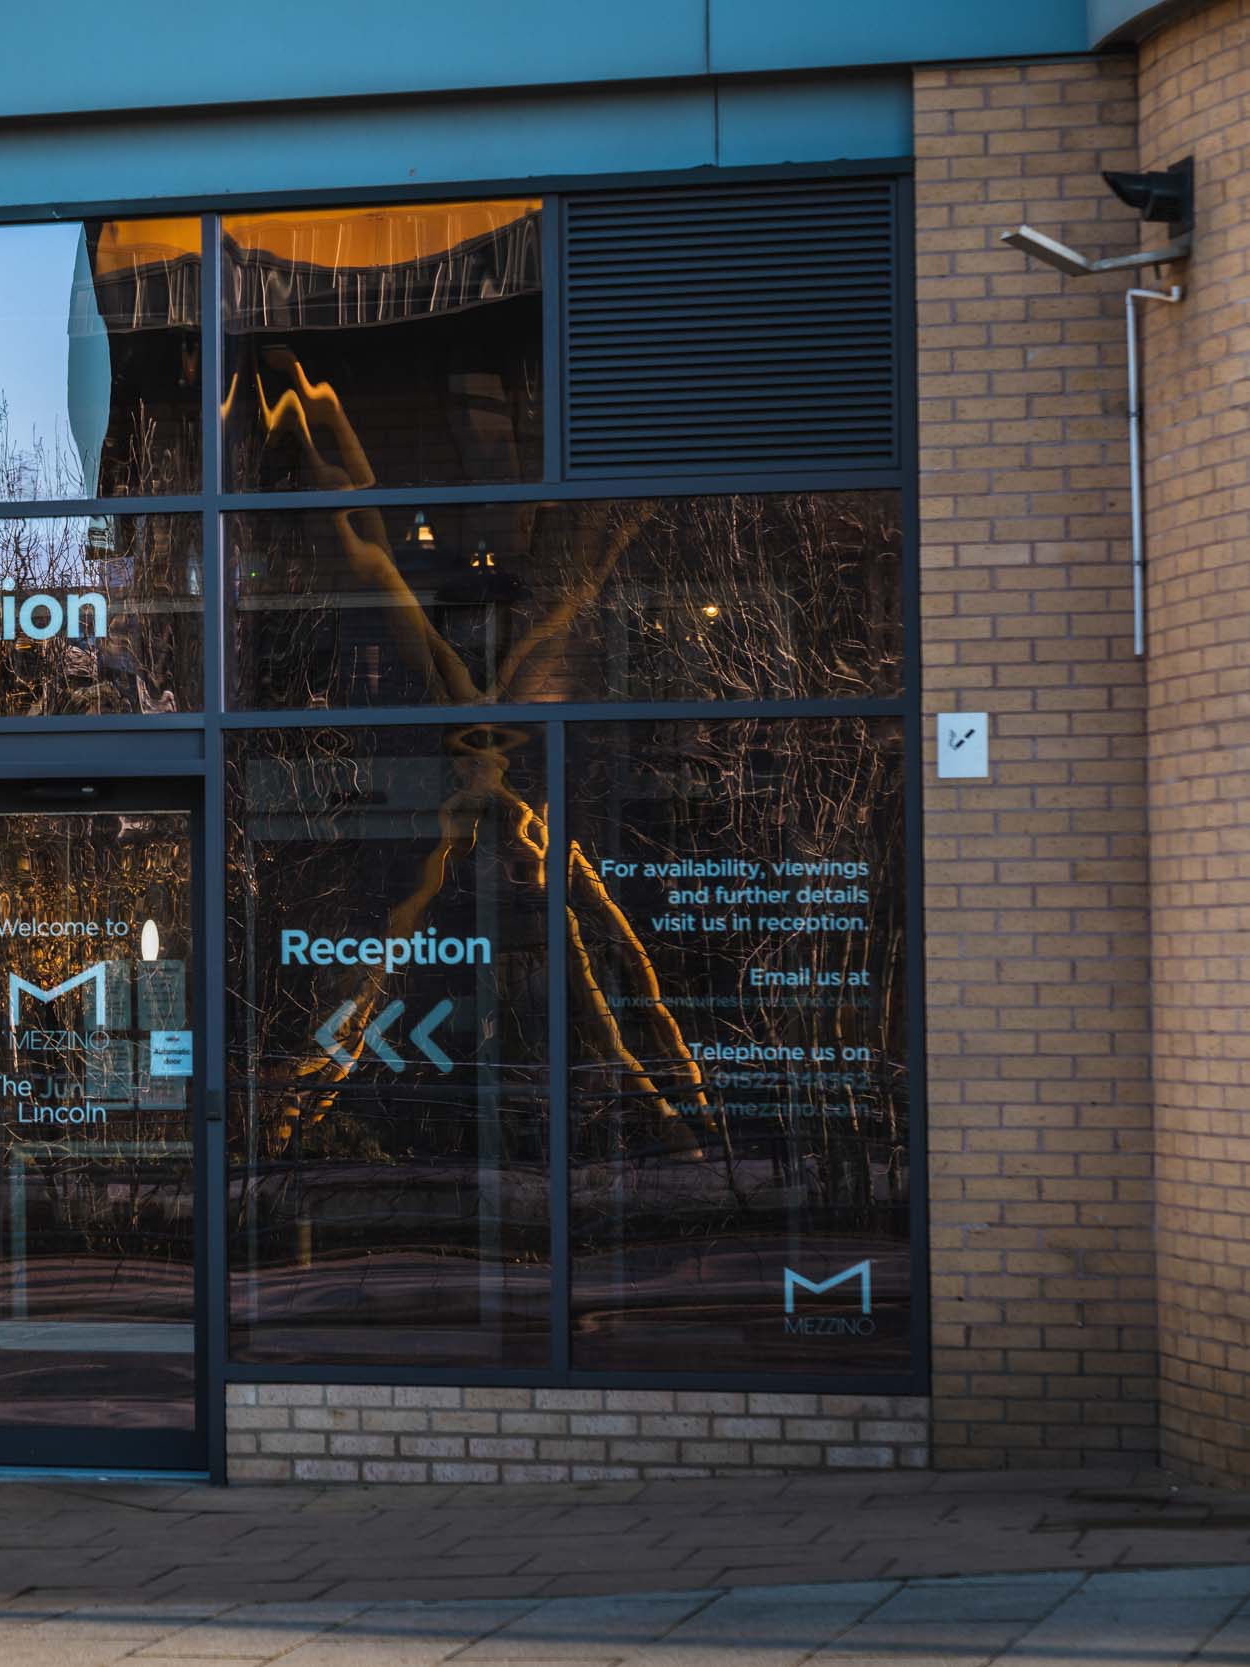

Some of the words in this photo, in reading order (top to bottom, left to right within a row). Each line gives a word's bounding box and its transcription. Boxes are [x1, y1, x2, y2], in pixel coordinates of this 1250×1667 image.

[601, 860, 636, 878] For
[643, 859, 767, 880] availability,
[773, 859, 869, 880] viewings
[668, 886, 709, 905] and
[715, 886, 792, 905] further
[796, 885, 869, 905] details
[106, 919, 128, 937] to
[652, 913, 695, 932] visit
[701, 917, 727, 932] us
[731, 912, 751, 933] in
[757, 913, 869, 935] reception.
[281, 927, 491, 974] Reception
[750, 968, 813, 987] Email
[817, 972, 842, 987] us
[846, 969, 869, 987] at
[10, 1030, 110, 1051] MEZZINO
[164, 1057, 182, 1065] door
[689, 1042, 806, 1064] Telephone
[812, 1046, 833, 1061] us
[840, 1046, 869, 1061] on
[714, 1072, 781, 1088] 01522
[18, 1101, 106, 1123] Lincoln
[783, 1317, 876, 1336] MEZZINO
